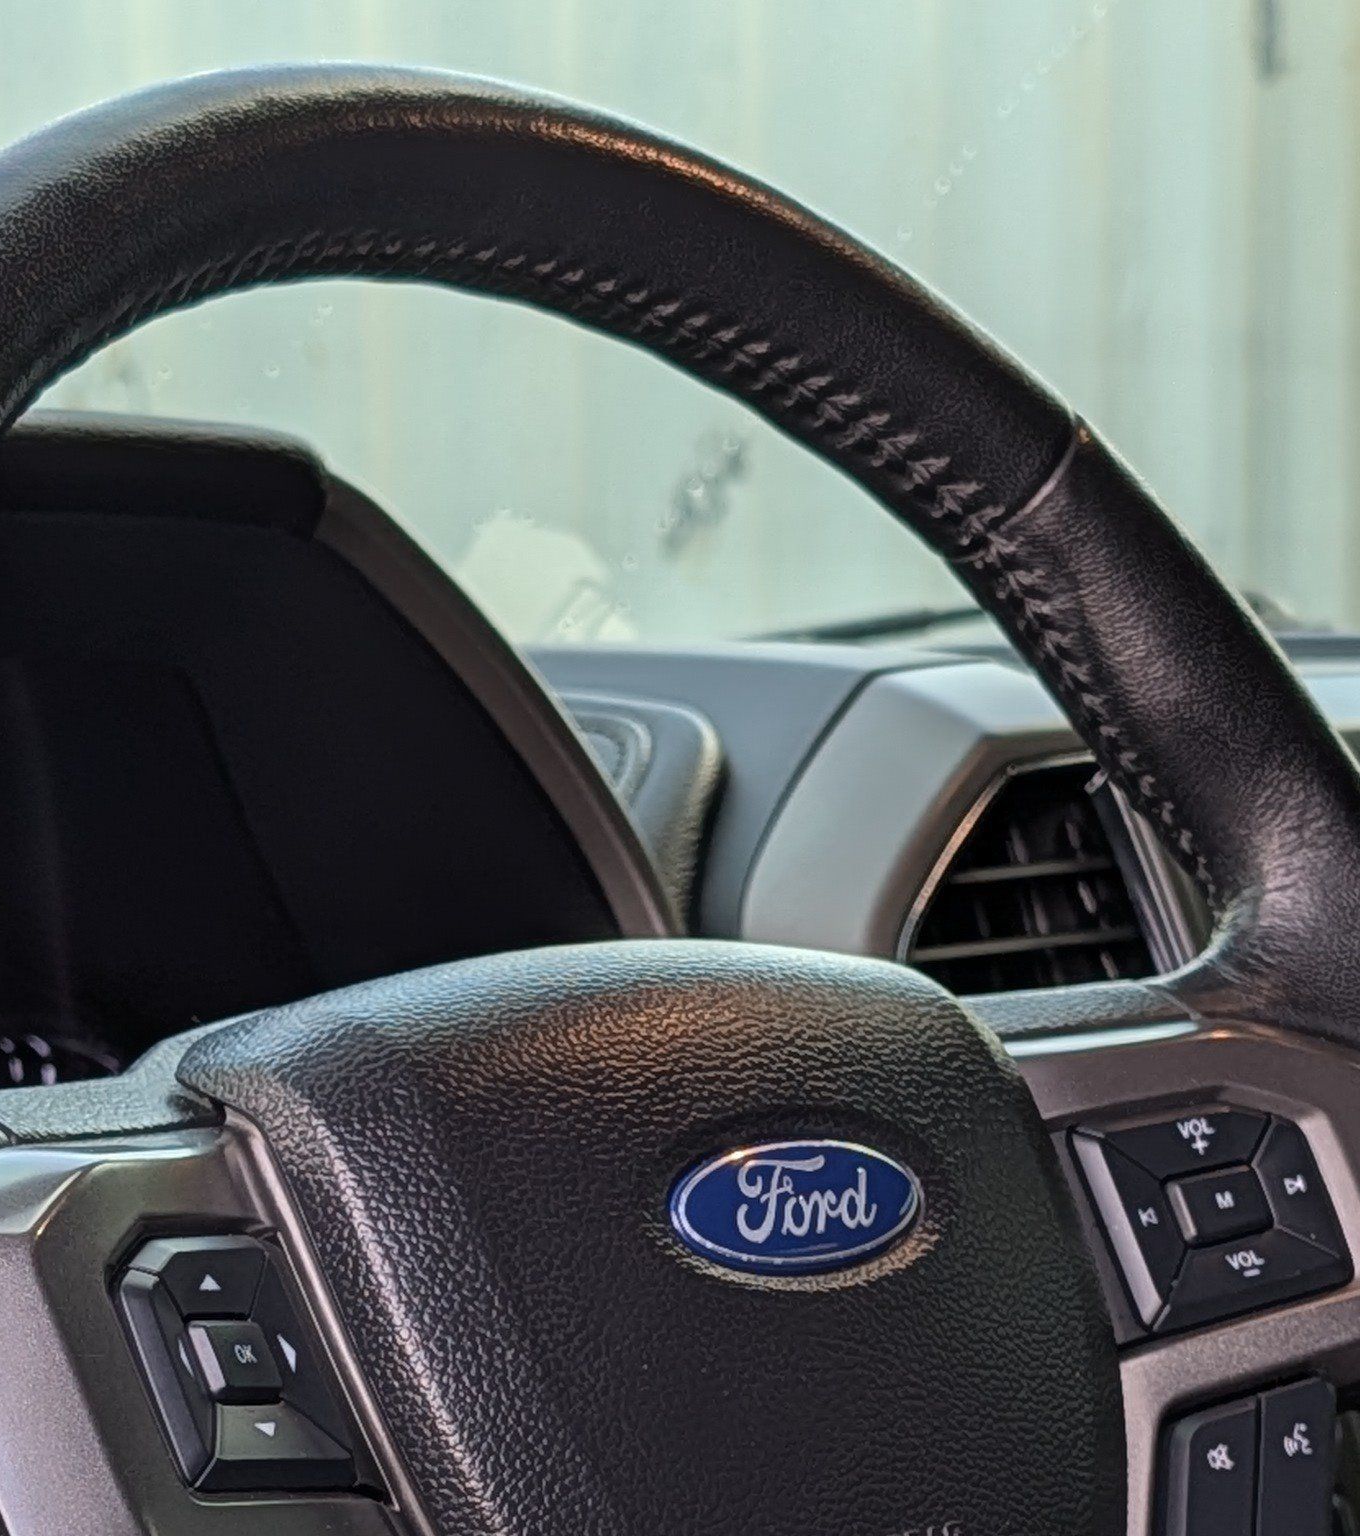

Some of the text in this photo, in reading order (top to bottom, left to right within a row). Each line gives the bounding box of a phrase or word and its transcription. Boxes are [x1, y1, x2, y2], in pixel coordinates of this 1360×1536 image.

[1176, 1117, 1215, 1139] VOL
[736, 1154, 877, 1243] Ford
[1215, 1190, 1235, 1209] M
[1225, 1250, 1265, 1270] VOL
[234, 1344, 258, 1363] OK
